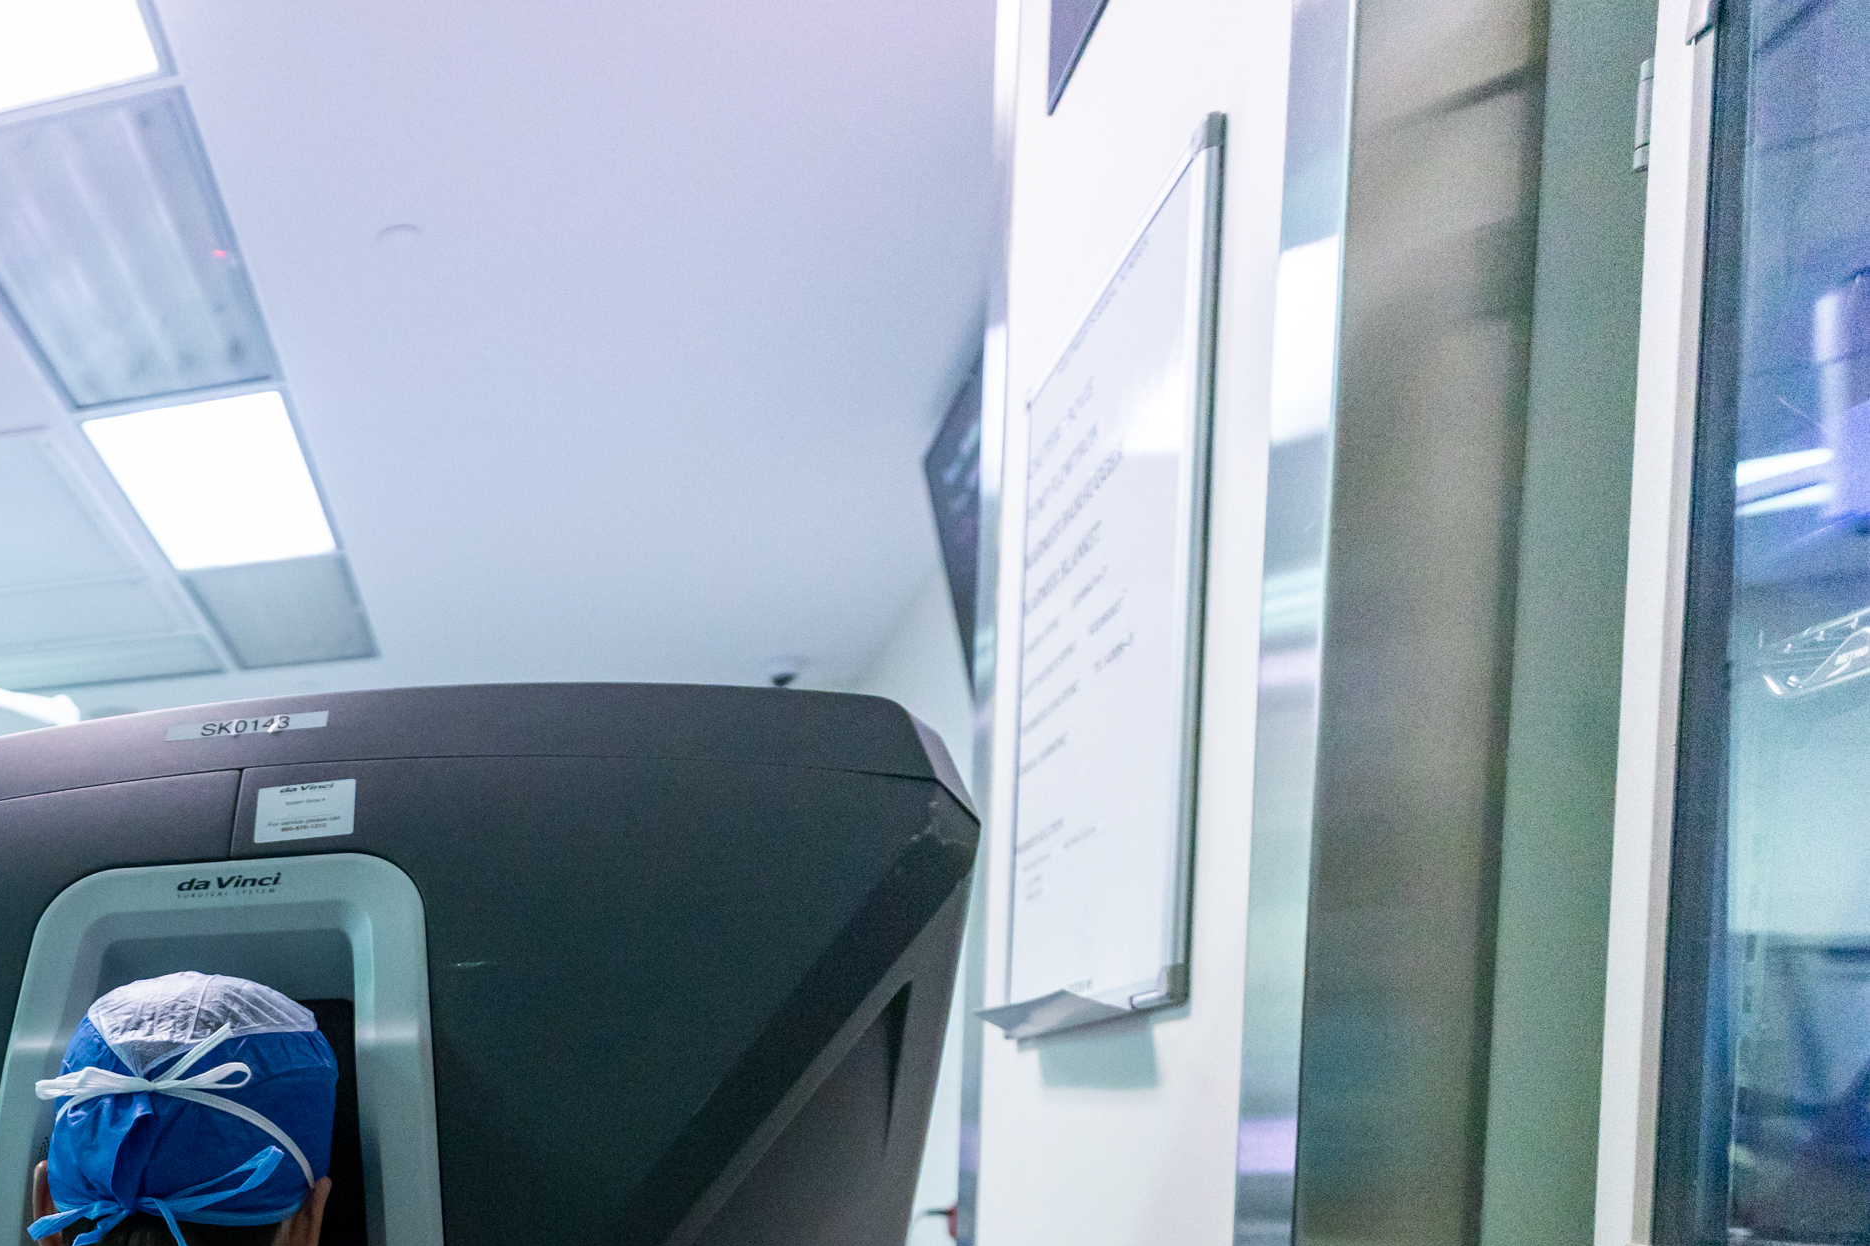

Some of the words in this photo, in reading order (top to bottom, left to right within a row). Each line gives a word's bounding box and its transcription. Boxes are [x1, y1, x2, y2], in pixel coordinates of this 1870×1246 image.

[200, 715, 291, 737] SK0143
[279, 786, 298, 794] da
[300, 782, 334, 791] Vinci
[177, 878, 211, 891] da
[216, 872, 282, 889] Vinci
